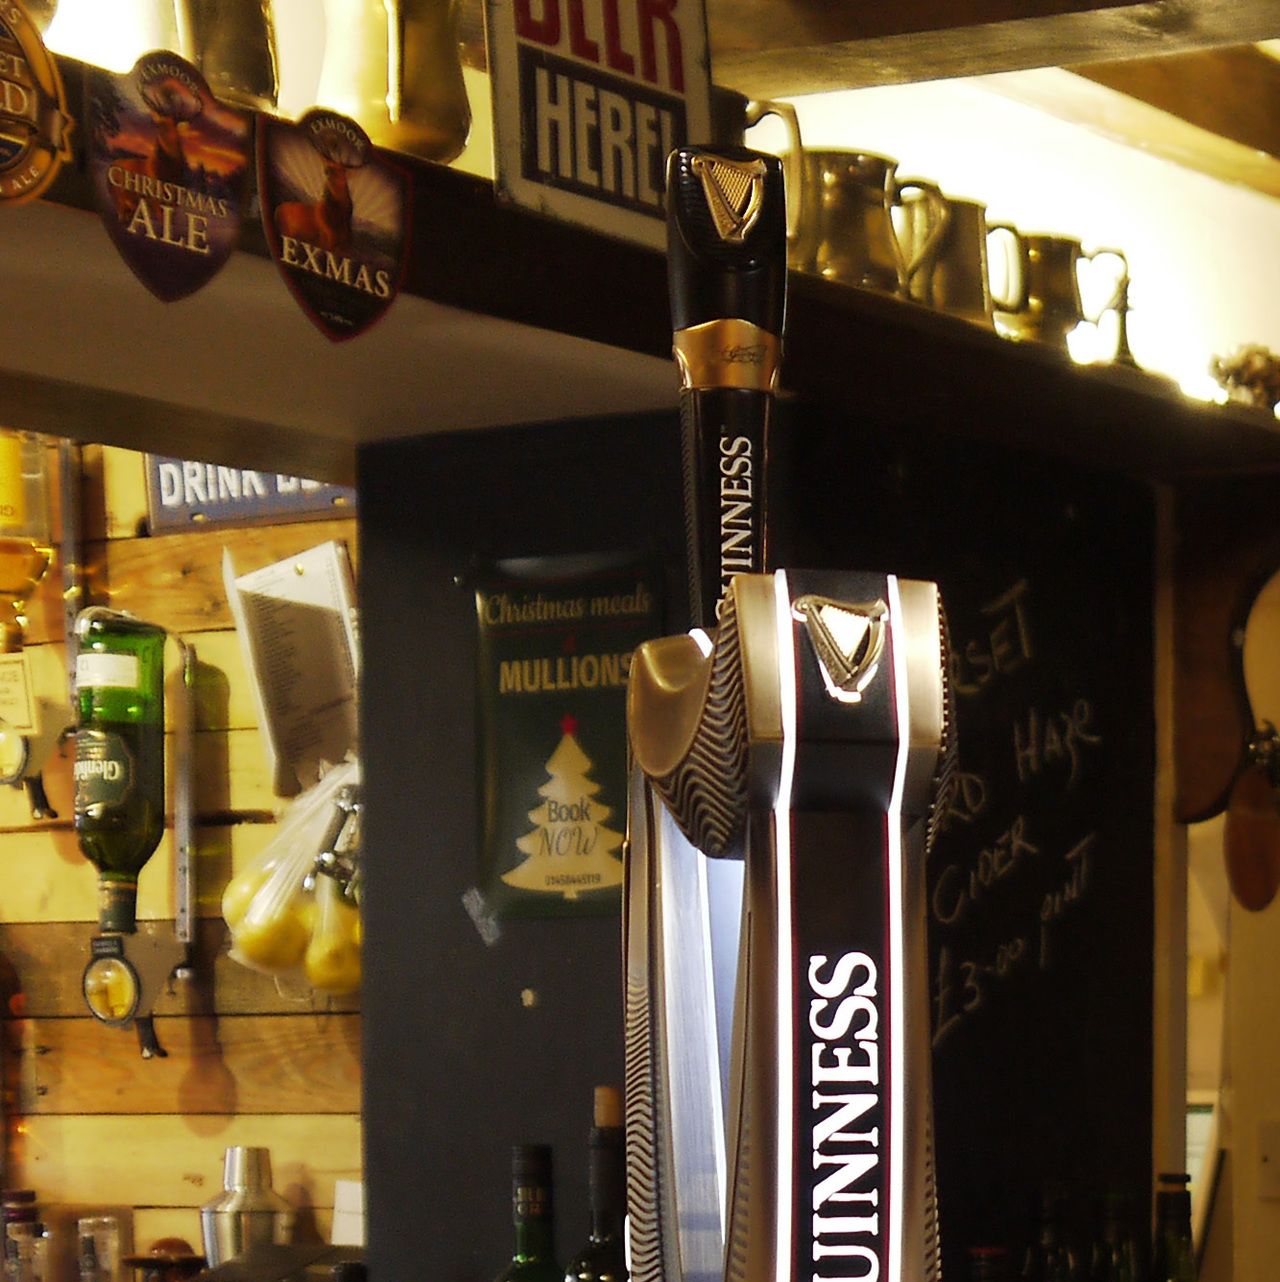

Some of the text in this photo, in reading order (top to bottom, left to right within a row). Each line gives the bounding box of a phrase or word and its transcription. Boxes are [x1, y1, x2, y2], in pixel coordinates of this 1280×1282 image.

[12, 165, 40, 191] ALE
[107, 166, 228, 218] CHRISTMAS
[127, 198, 211, 255] ALE
[280, 235, 391, 298] EXMAS
[715, 436, 753, 621] INNESS
[486, 582, 652, 625] Christmas meals
[500, 652, 635, 693] MULLIONS
[548, 799, 592, 823] Book
[537, 826, 600, 857] NOW
